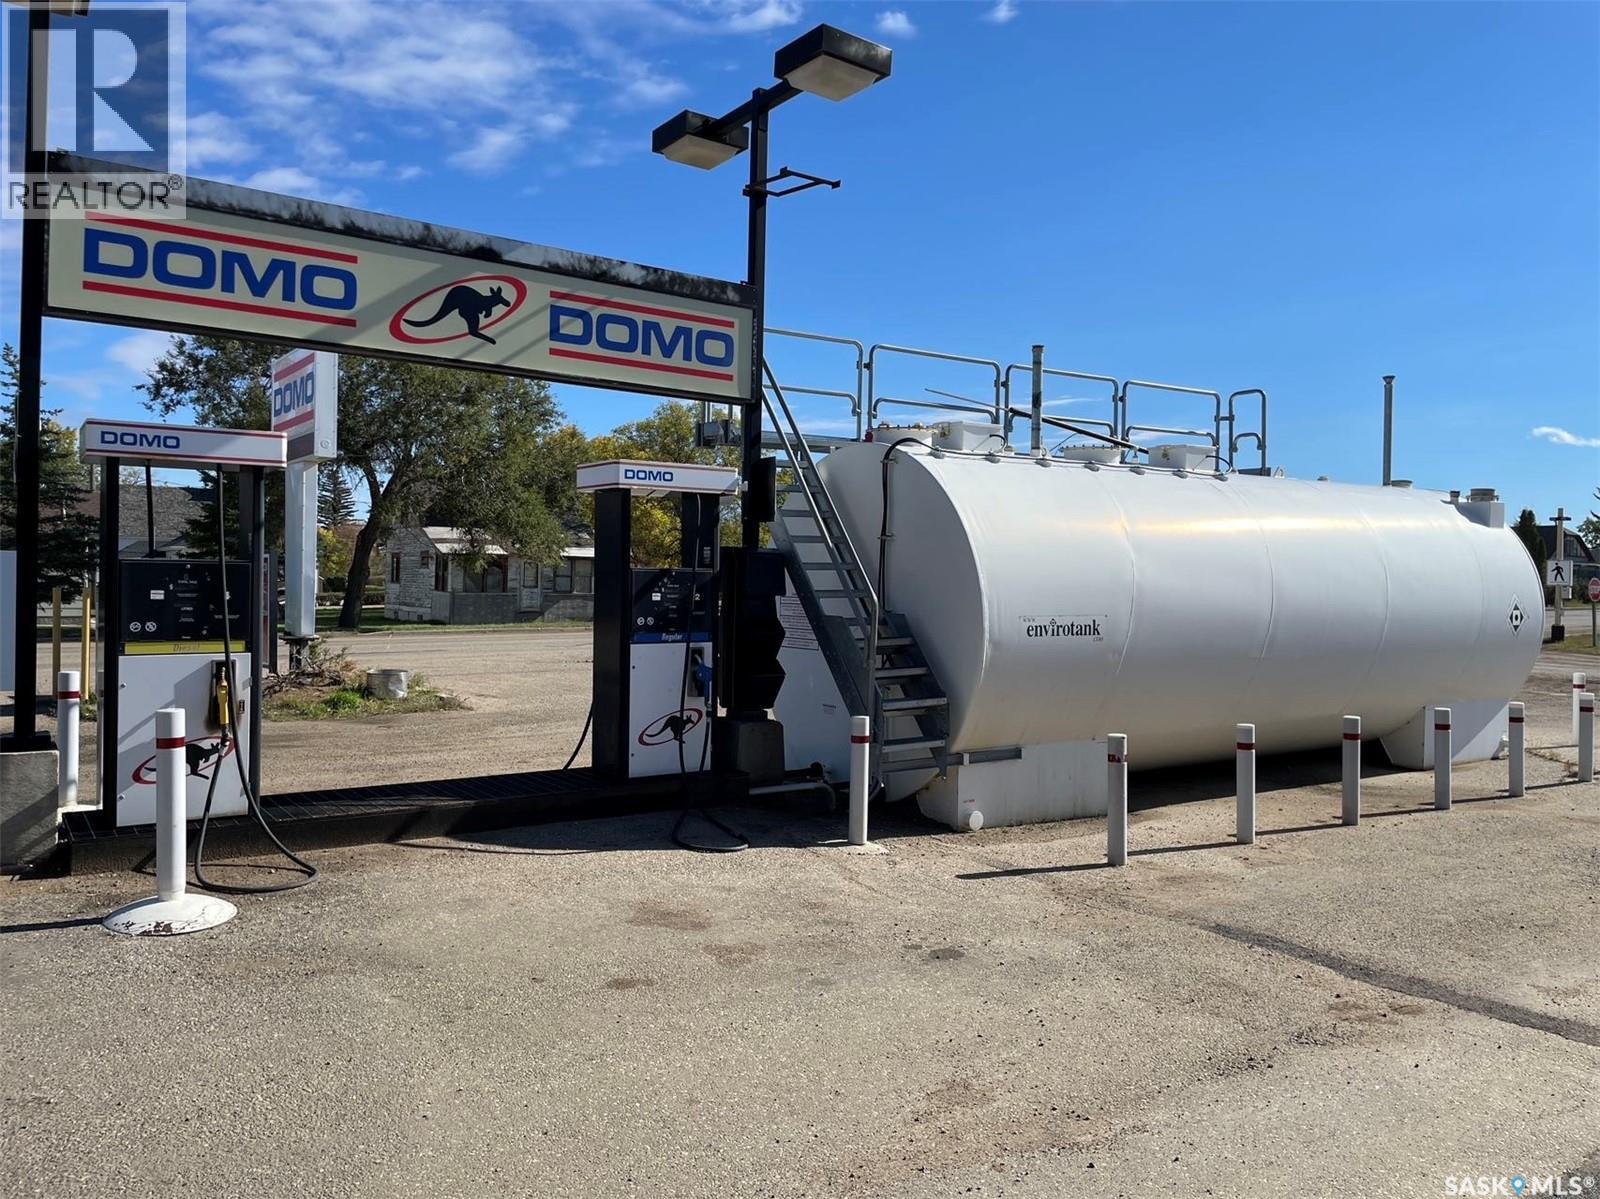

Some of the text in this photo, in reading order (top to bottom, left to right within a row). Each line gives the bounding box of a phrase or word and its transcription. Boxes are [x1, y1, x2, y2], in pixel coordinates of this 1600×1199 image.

[83, 227, 357, 311] DOMO
[549, 304, 734, 368] DOMO
[273, 371, 314, 418] DOMO
[100, 430, 181, 449] DOMO
[624, 468, 674, 483] DOMO
[661, 632, 684, 642] Regular
[1026, 618, 1101, 637] envirotank
